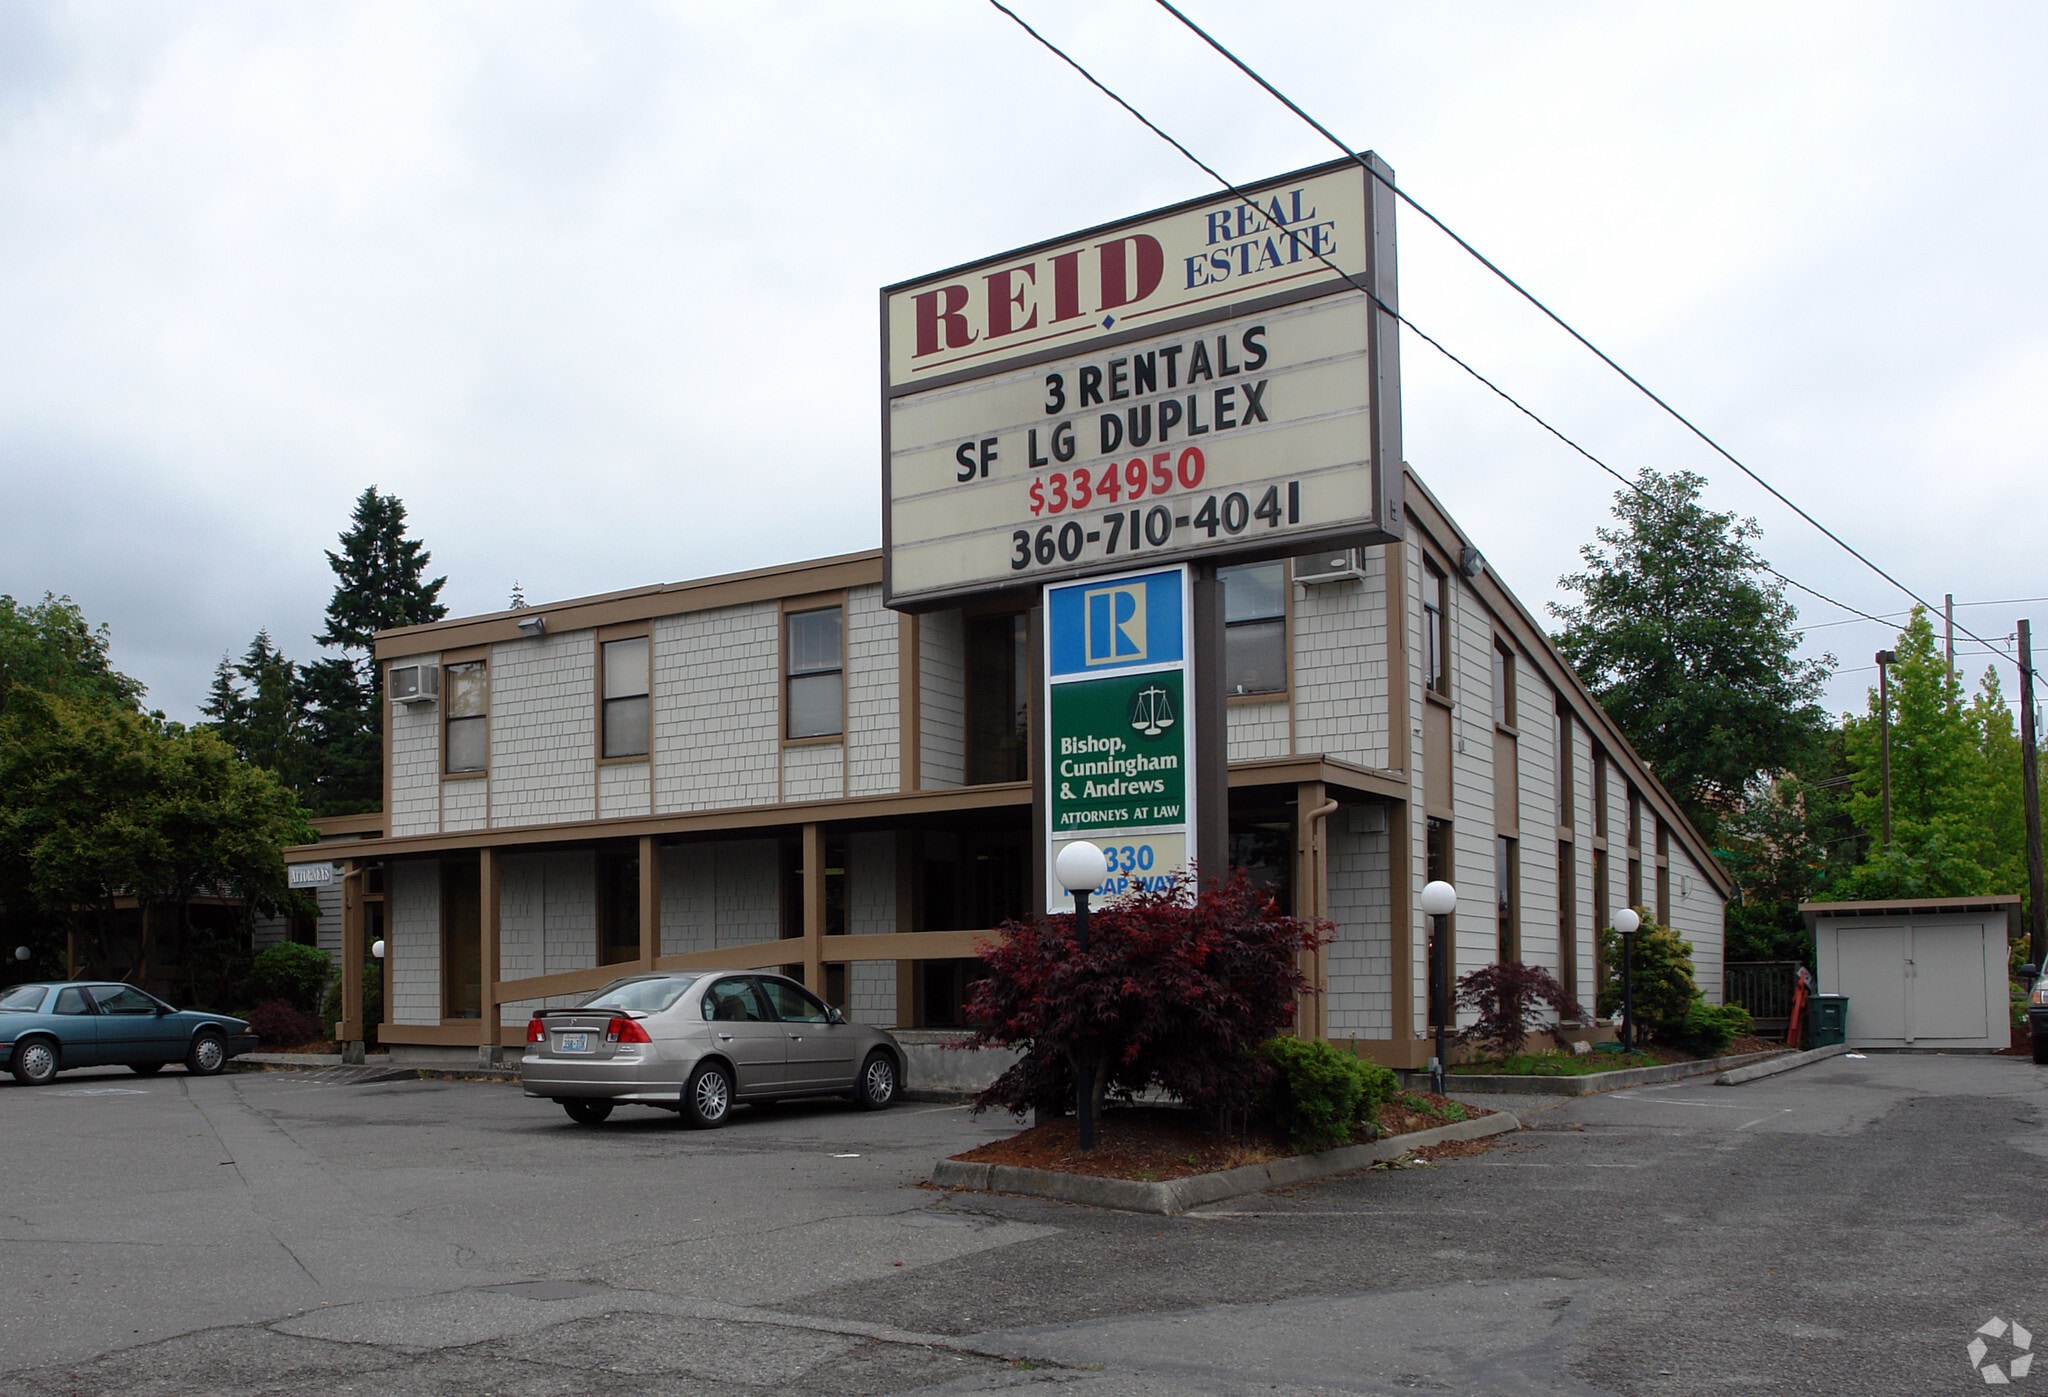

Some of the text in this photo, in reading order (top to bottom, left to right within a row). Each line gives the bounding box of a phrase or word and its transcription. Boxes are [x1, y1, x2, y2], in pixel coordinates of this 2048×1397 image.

[1205, 189, 1315, 246] REAL
[1184, 221, 1336, 290] ESTATE
[911, 234, 1164, 359] REID
[1045, 326, 1268, 415] 3 RENTALS
[956, 379, 1269, 482] SF LG DUPLEX
[1029, 446, 1205, 516] $334950
[1011, 480, 1300, 570] 360-710-4041
[1060, 753, 1178, 777] Cunningham
[1061, 735, 1127, 755] Bishop,
[1060, 778, 1165, 800] & Andrews
[1060, 804, 1180, 825] ATTORNEYS AT LAW
